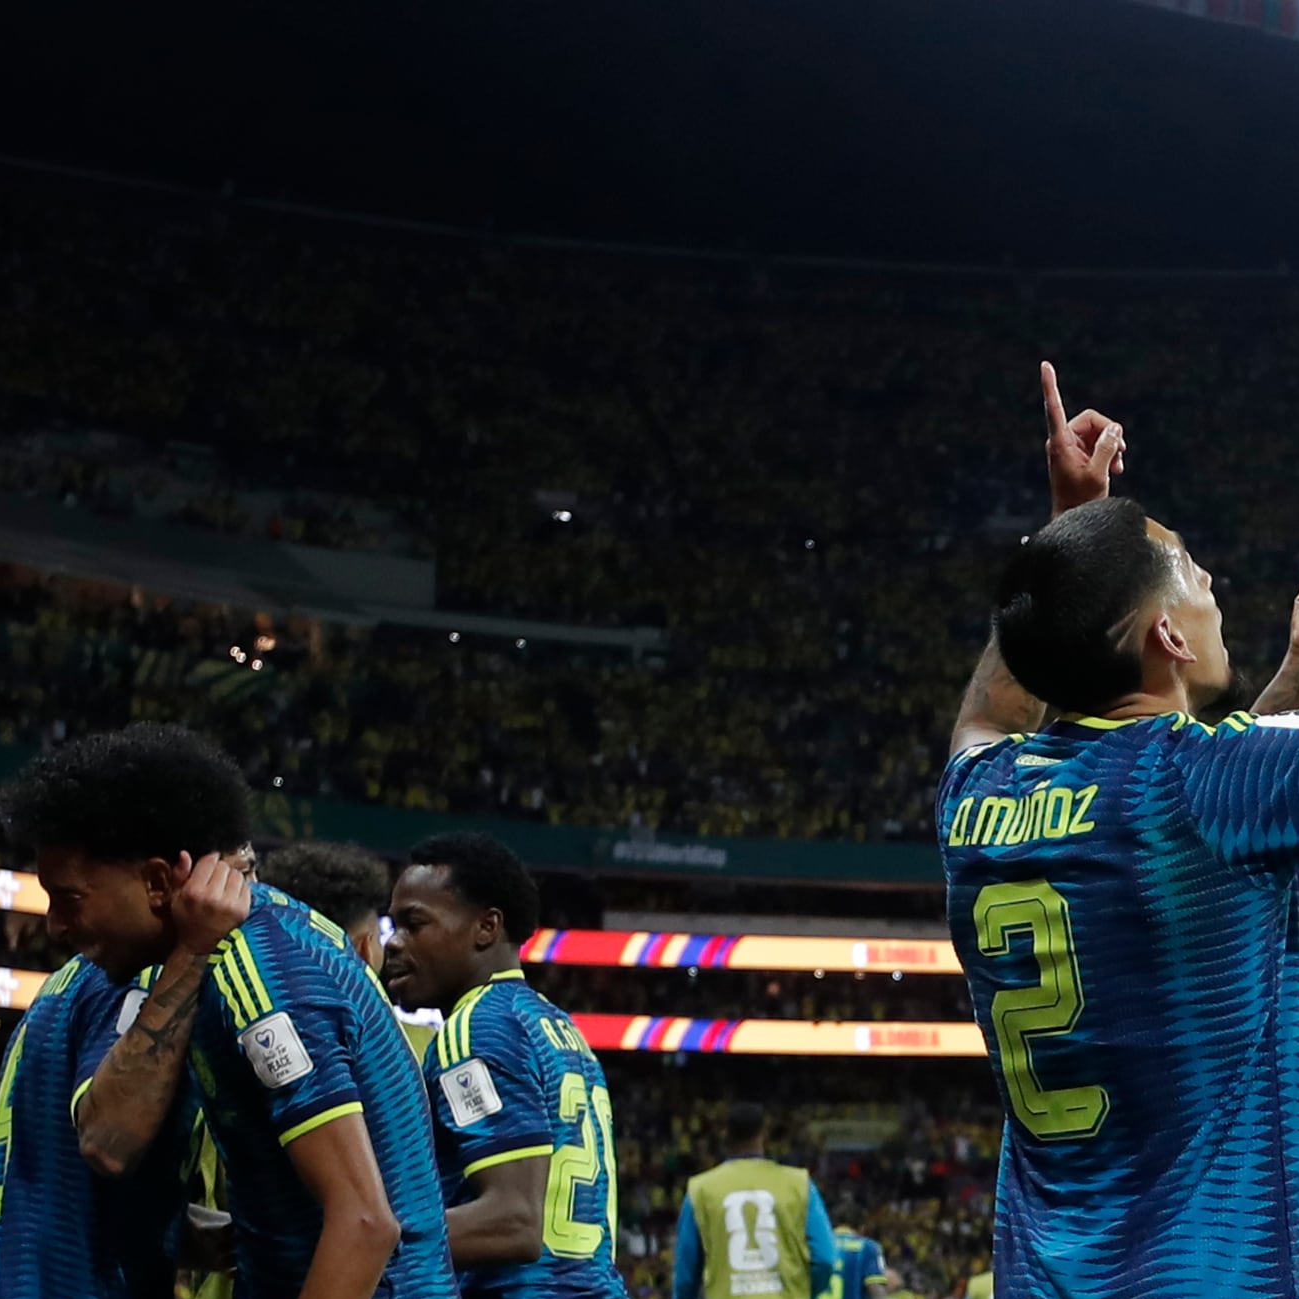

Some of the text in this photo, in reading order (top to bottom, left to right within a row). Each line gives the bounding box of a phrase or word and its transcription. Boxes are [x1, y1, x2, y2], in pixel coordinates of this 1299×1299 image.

[948, 778, 1099, 846] D.MUÑOZ
[973, 879, 1110, 1141] 2
[267, 1055, 292, 1074] PEACE
